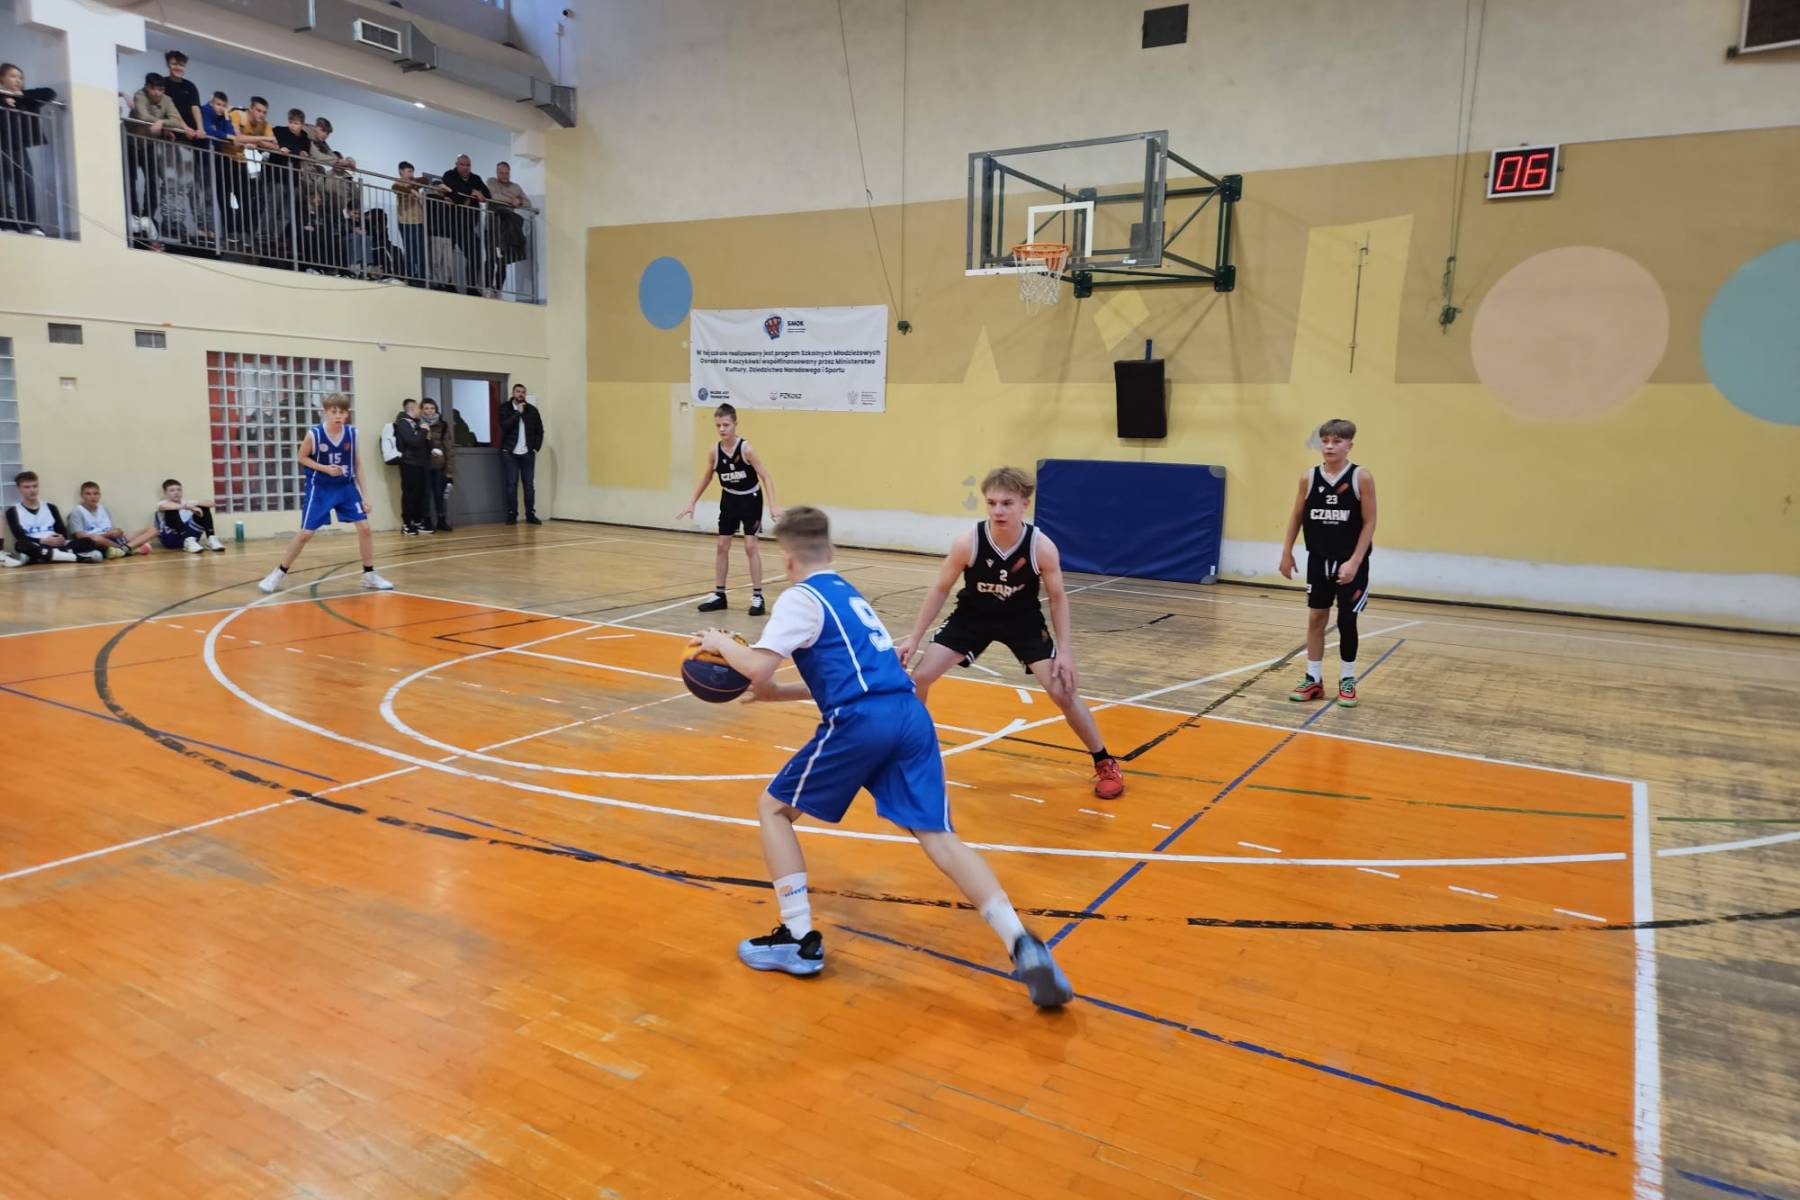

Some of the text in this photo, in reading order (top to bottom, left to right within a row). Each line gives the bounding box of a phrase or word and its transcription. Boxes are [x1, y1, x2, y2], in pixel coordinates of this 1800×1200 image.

[1495, 153, 1549, 191] 06
[775, 350, 800, 358] program
[801, 349, 832, 357] Szkolnych
[818, 359, 834, 367] przez
[784, 367, 822, 375] Narodowego
[825, 367, 846, 375] Sportu
[328, 452, 342, 464] 15
[1326, 494, 1338, 505] 23
[1000, 569, 1008, 582] 2
[848, 596, 894, 653] 9
